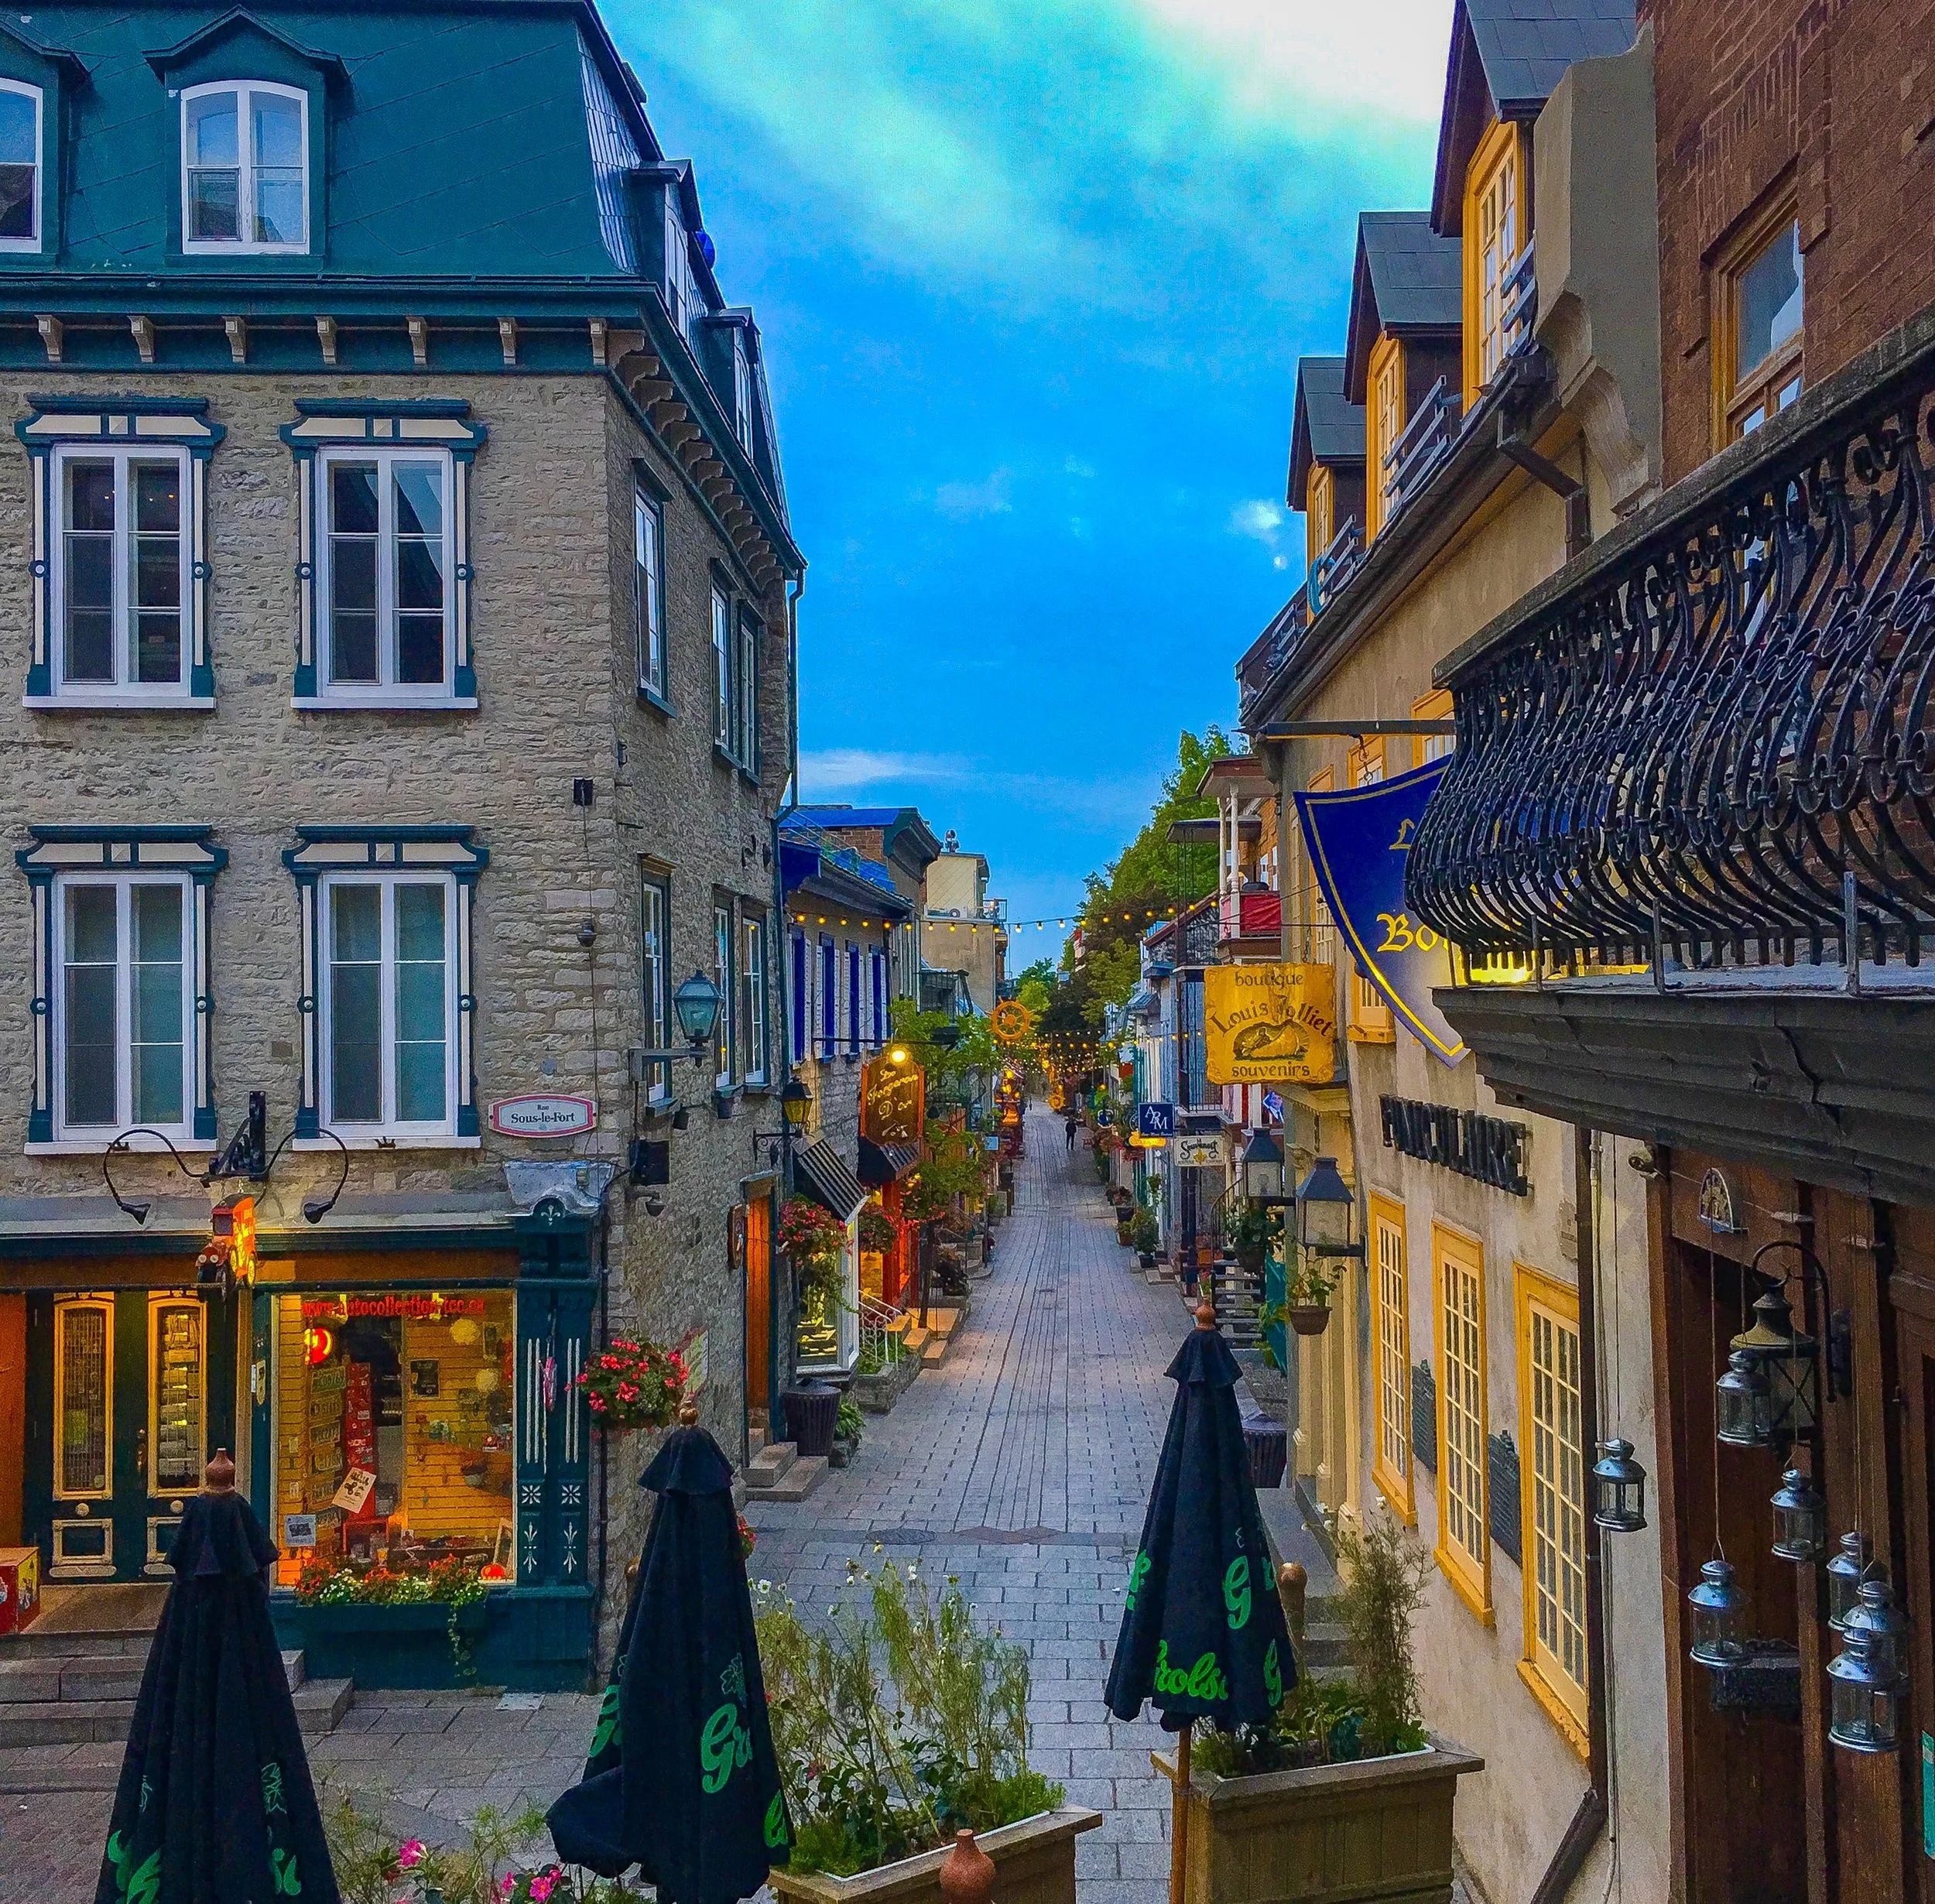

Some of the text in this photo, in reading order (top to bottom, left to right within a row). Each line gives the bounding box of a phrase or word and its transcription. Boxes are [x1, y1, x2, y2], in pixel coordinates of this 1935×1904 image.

[1235, 971, 1303, 990] boutique
[1207, 995, 1334, 1037] Louis Jolliet
[1231, 1060, 1310, 1077] souvenirs
[511, 1112, 576, 1123] Sous-le-Fort
